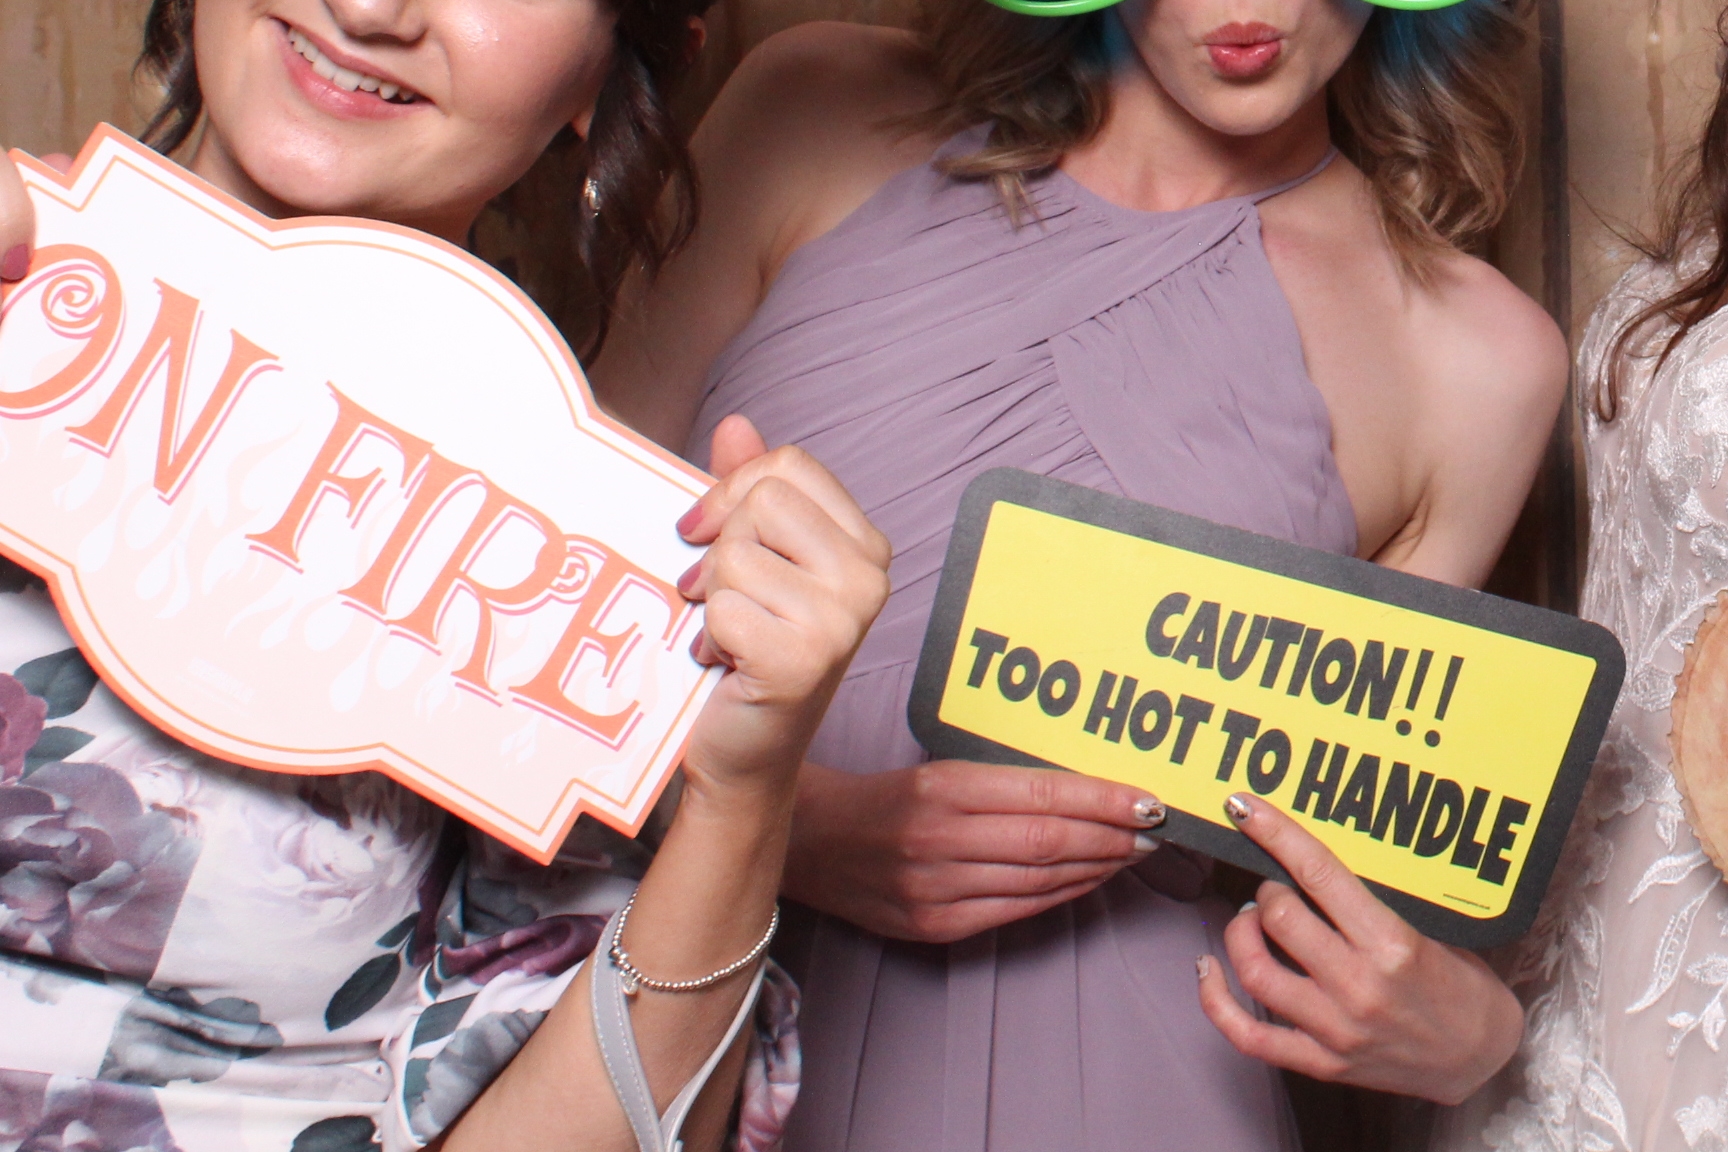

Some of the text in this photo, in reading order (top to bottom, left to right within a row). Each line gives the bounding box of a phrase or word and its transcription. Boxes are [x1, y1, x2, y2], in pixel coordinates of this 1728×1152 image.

[0, 244, 699, 752] ON FIRE
[967, 628, 1532, 887] TOO HOT TO HANDLE
[1145, 592, 1464, 747] CAUTION!!
